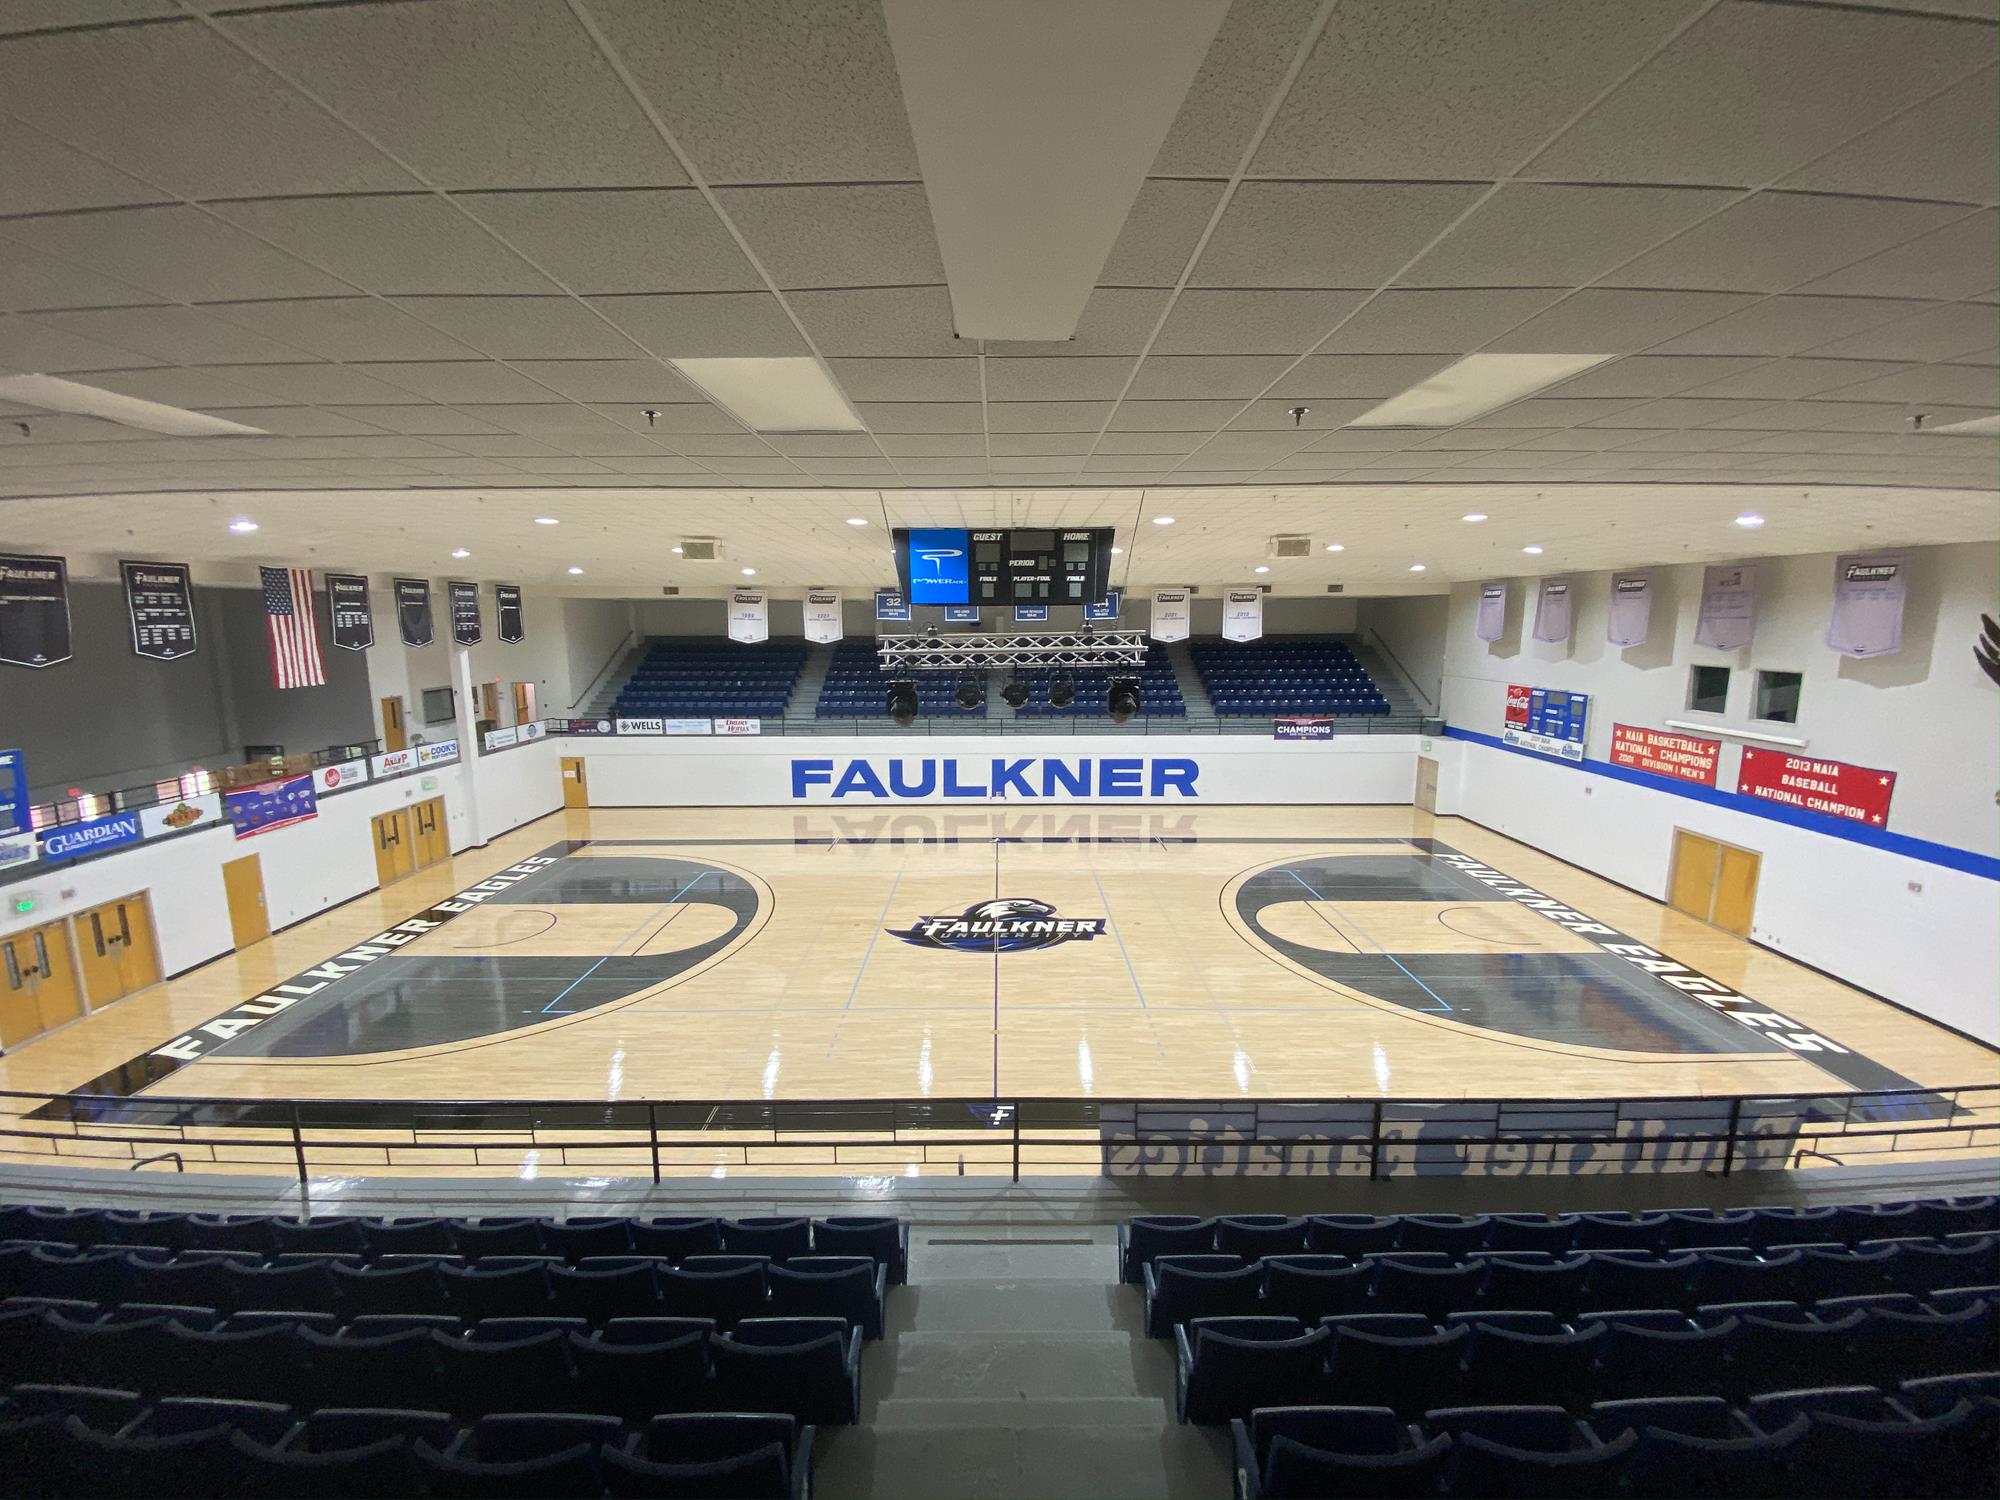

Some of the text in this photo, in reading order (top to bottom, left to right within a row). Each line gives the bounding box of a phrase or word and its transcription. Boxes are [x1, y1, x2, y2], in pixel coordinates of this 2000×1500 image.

[973, 533, 1002, 541] GUEST
[1063, 532, 1090, 540] HOME
[1009, 559, 1035, 567] PERIOD
[1847, 565, 1897, 578] FAULKNER
[886, 598, 901, 606] 32
[631, 721, 660, 730] WELLS
[1277, 726, 1331, 734] CHAMPIONS
[431, 743, 456, 755] COOK'S
[1625, 730, 1704, 754] NAIA BASKETBALL
[1615, 741, 1713, 769] NATIONAL CHAMPIONS
[1642, 758, 1673, 773] DIVISION
[1680, 767, 1705, 780] MEN'S
[1785, 758, 1840, 777] 2013 NAIA
[791, 758, 1200, 798] FAULKNER
[1781, 774, 1839, 795] BASEBALL
[1754, 785, 1866, 820] NATIONAL CHAMPION
[45, 818, 136, 855] GUARDIAN
[921, 918, 1097, 936] FAULKNER
[151, 856, 560, 1061] FAULKNER EAGLES
[1433, 853, 1850, 1054] FAULKNER EAGLES
